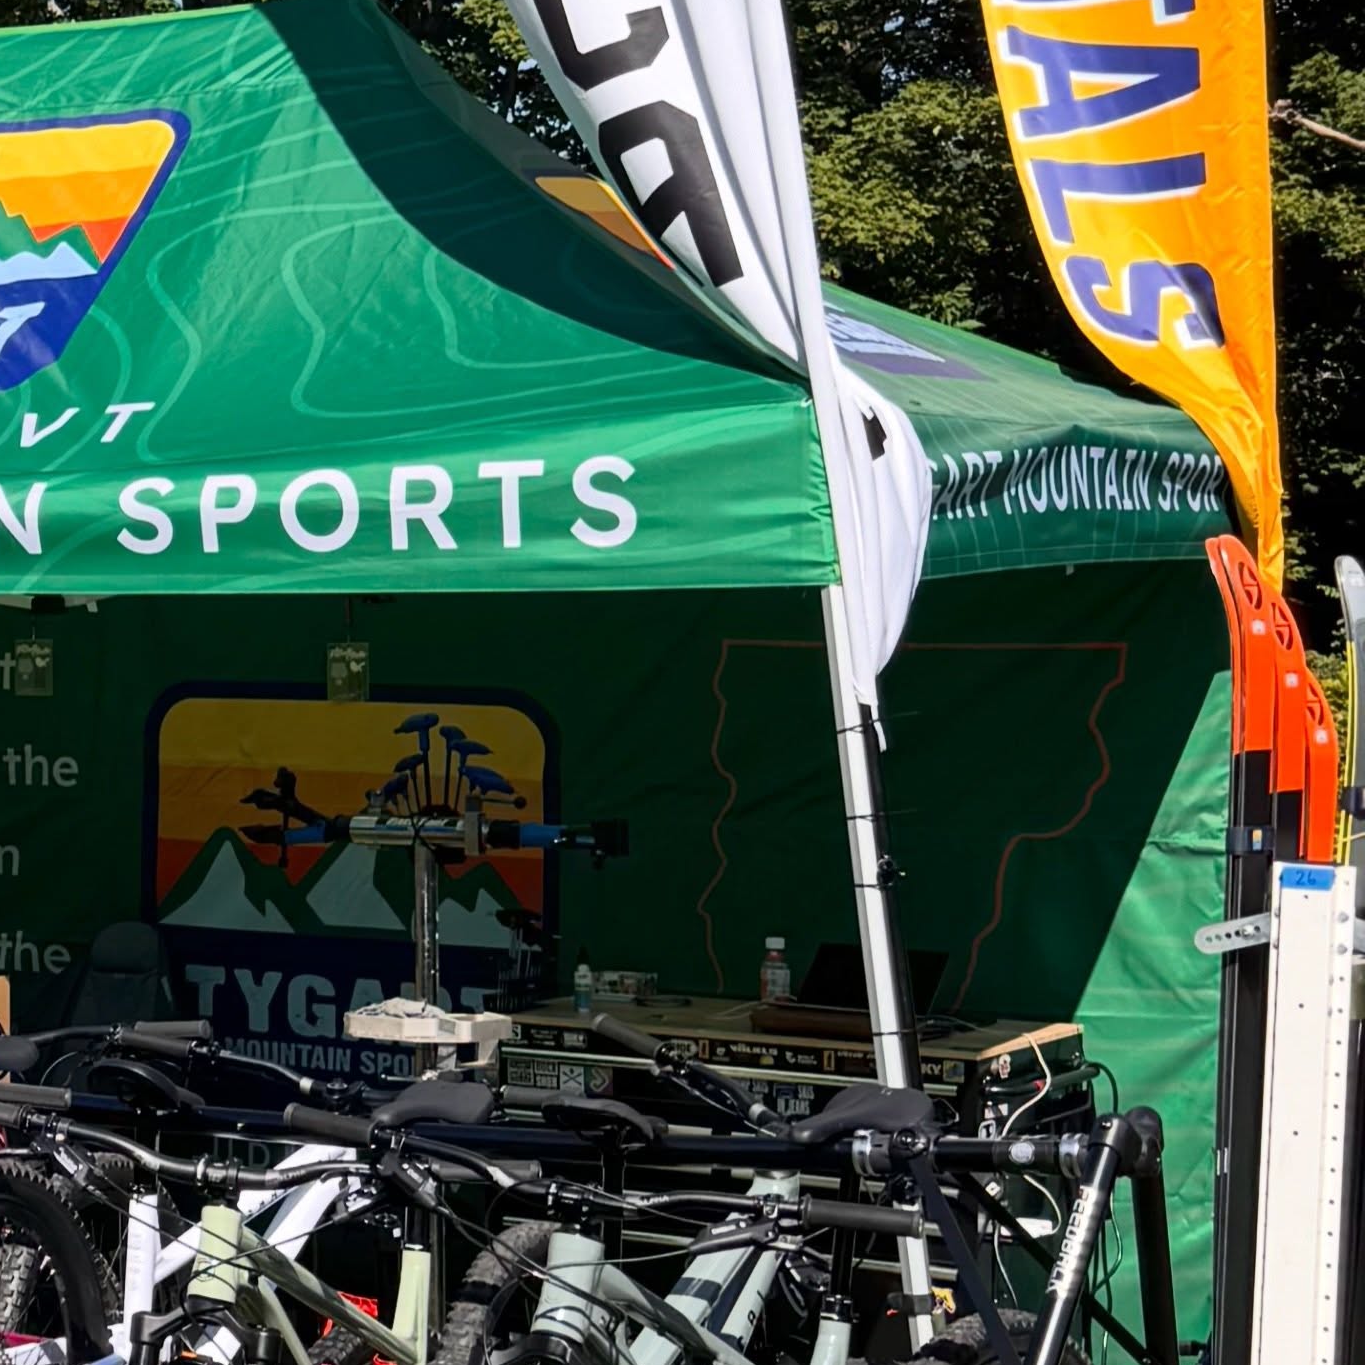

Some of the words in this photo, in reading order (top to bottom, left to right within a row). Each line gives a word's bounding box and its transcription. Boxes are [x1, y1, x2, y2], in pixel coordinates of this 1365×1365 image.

[19, 402, 156, 448] VT
[116, 455, 639, 555] SPORTS
[1002, 445, 1159, 515] MOUNTAIN
[2, 743, 80, 789] the
[1295, 869, 1317, 886] 26
[1045, 1184, 1094, 1298] FEEDBACK
